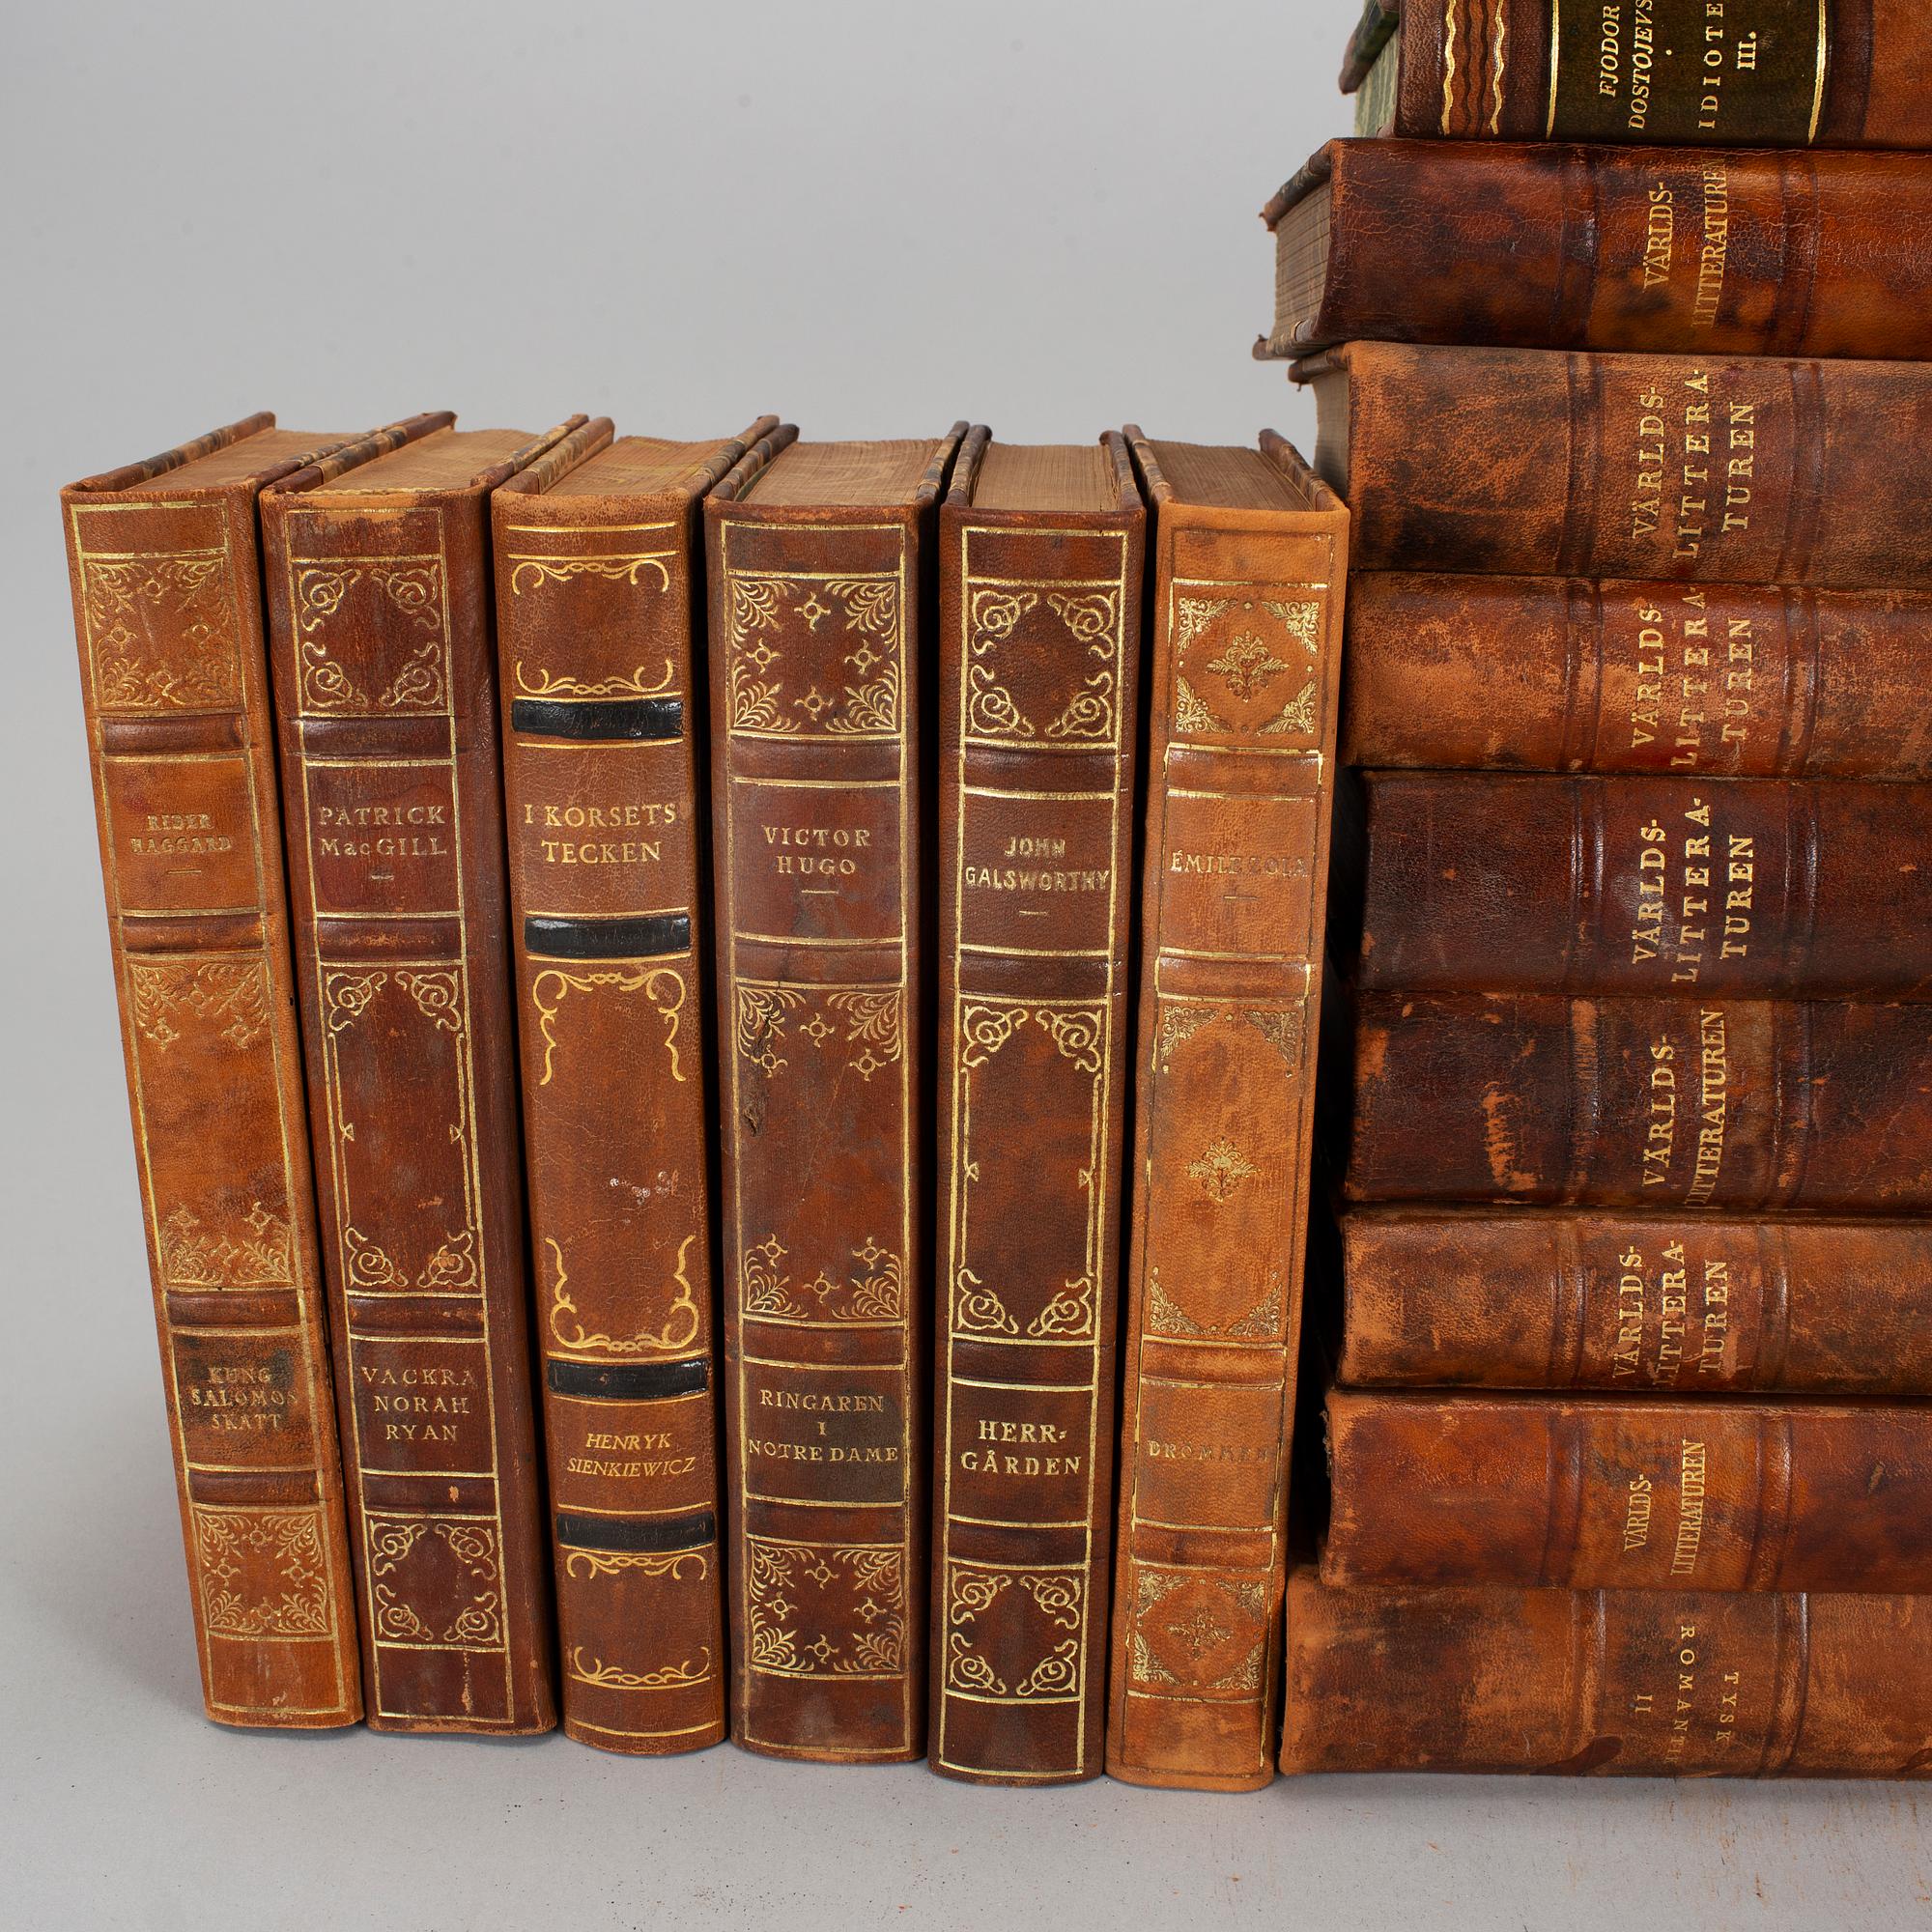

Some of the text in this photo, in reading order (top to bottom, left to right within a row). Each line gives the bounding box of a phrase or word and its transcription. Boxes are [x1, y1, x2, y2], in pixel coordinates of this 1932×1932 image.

[1599, 5, 1621, 98] FJODOR
[1737, 31, 1757, 70] III.
[1642, 182, 1673, 294] VÄRLDS-
[1632, 386, 1664, 539] VÄRLDS-
[1672, 369, 1710, 559] LITTERA-
[1721, 401, 1755, 533] TUREN
[1631, 602, 1664, 749] VÄRLDS-
[1670, 586, 1709, 767] LITTERA-
[1720, 615, 1752, 743] TUREN
[147, 813, 213, 831] RIDER
[319, 805, 446, 827] PATRICK
[525, 803, 676, 828] I KORSETS
[129, 836, 233, 855] HAGGARD
[320, 838, 448, 857] MacGILL
[762, 825, 870, 847] VICTOR
[1004, 837, 1066, 858] JOHN
[541, 839, 663, 865] TECKEN
[1171, 849, 1242, 874] ÉMILE
[777, 855, 857, 876] HUGO
[965, 866, 1111, 892] GALSWORTHY
[1632, 819, 1666, 965] VÄRLDS-
[1671, 797, 1711, 982] LITTERA-
[1719, 835, 1754, 960] TUREN
[1642, 1034, 1676, 1187] VÄRLDS-
[1685, 1007, 1727, 1205] LITTERATUREN
[1612, 1245, 1644, 1379] VÄRLDS-
[1653, 1239, 1687, 1386] LITTERA-
[1698, 1260, 1728, 1374] TUREN
[207, 1366, 272, 1385] KUNG
[361, 1365, 478, 1387] VACKRA
[191, 1388, 298, 1407] SALOMOS
[373, 1394, 471, 1414] NORAH
[760, 1389, 884, 1412] RINGAREN
[212, 1413, 283, 1431] SKATT
[385, 1423, 458, 1442] RYAN
[817, 1421, 827, 1436] I
[585, 1433, 672, 1451] HENRYK
[748, 1438, 899, 1463] NOTRE DAME
[566, 1457, 696, 1479] SIENKIEWICZ
[960, 1449, 1082, 1476] GÅRDEN
[1623, 1474, 1653, 1552] VÄRLDS-
[1670, 1438, 1706, 1577] LITTERATUREN
[1634, 1694, 1654, 1714] II
[1716, 1671, 1740, 1742] TYSK
